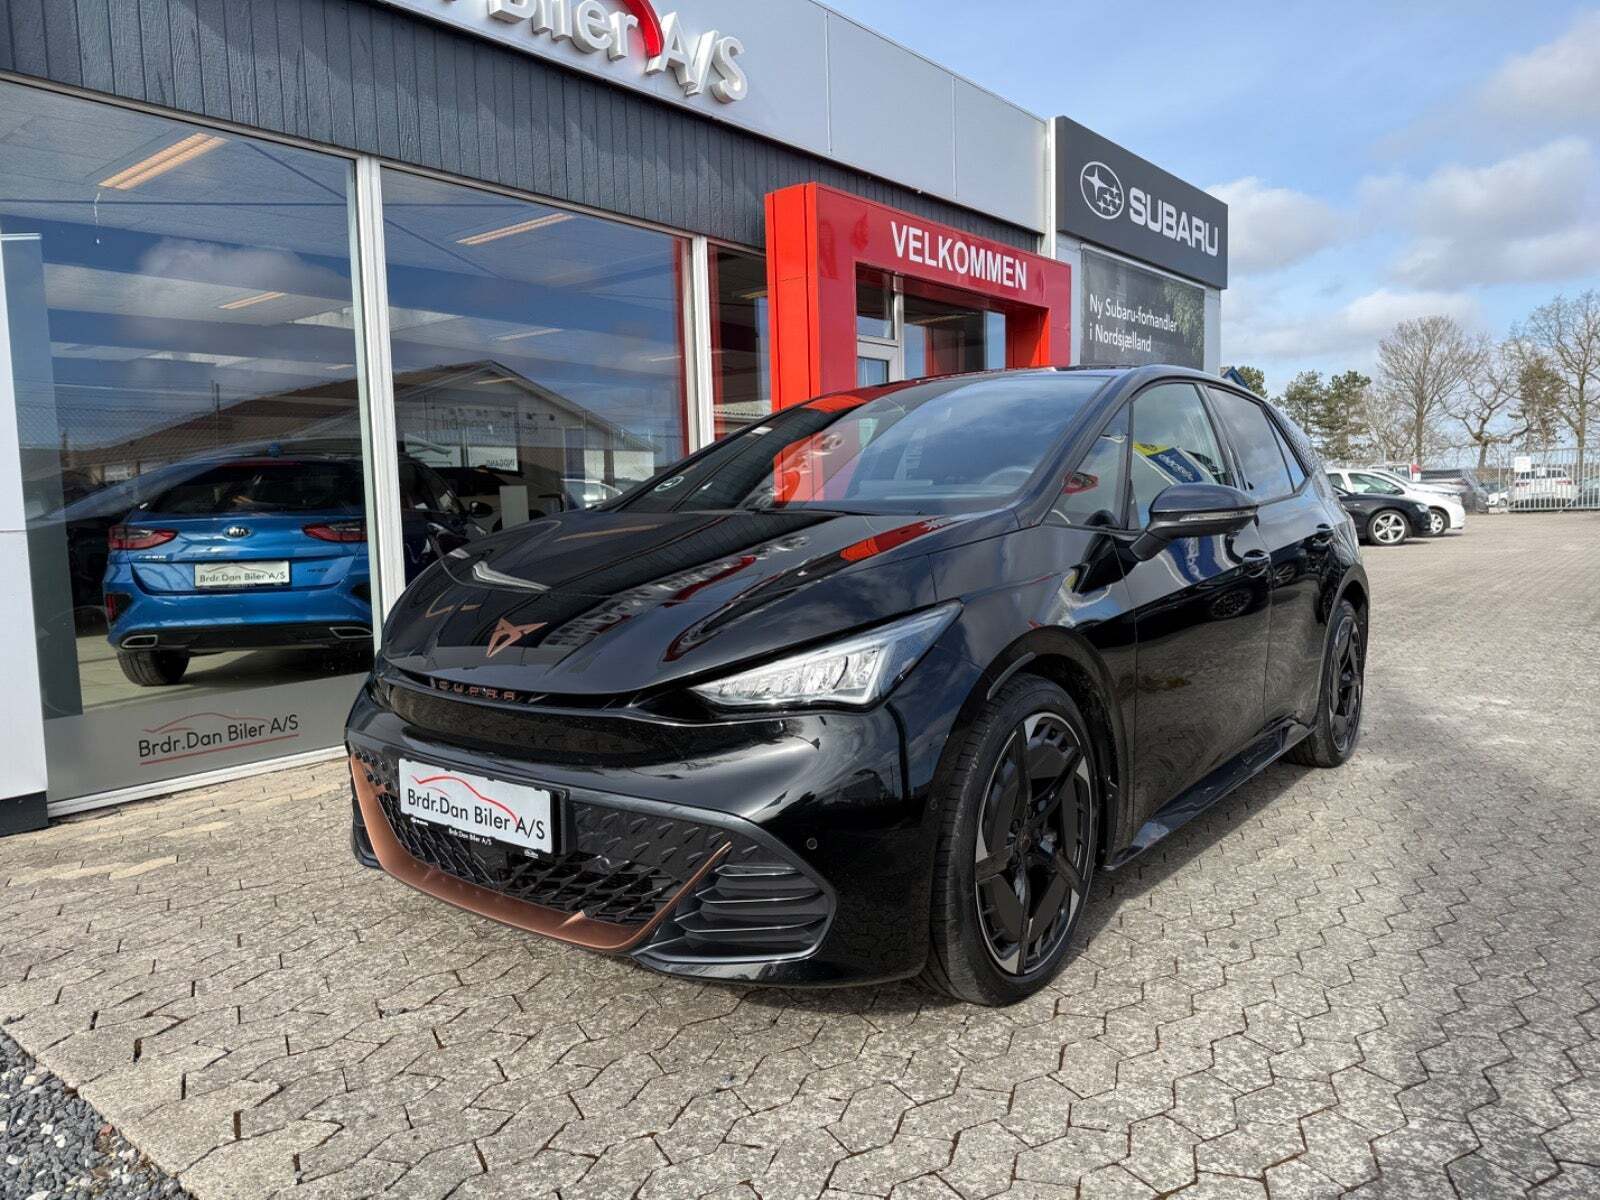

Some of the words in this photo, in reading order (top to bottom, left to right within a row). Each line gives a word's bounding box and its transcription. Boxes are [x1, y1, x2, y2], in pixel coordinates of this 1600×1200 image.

[646, 11, 748, 103] A/S
[1128, 186, 1219, 257] SUBARU
[891, 220, 1027, 291] VELKOMMEN
[1089, 293, 1103, 319] Ny
[1105, 298, 1178, 333] Subaru-forhandler
[1089, 322, 1093, 342] i
[1095, 327, 1152, 353] Nordsjælland
[244, 572, 266, 581] Biler
[268, 570, 286, 580] A/S
[138, 731, 223, 758] Brdr.Dan
[227, 722, 265, 742] Biler
[270, 713, 299, 733] A/S
[407, 788, 469, 821] Brdr.Dan
[474, 806, 511, 831] Biler
[514, 815, 546, 841] A/S
